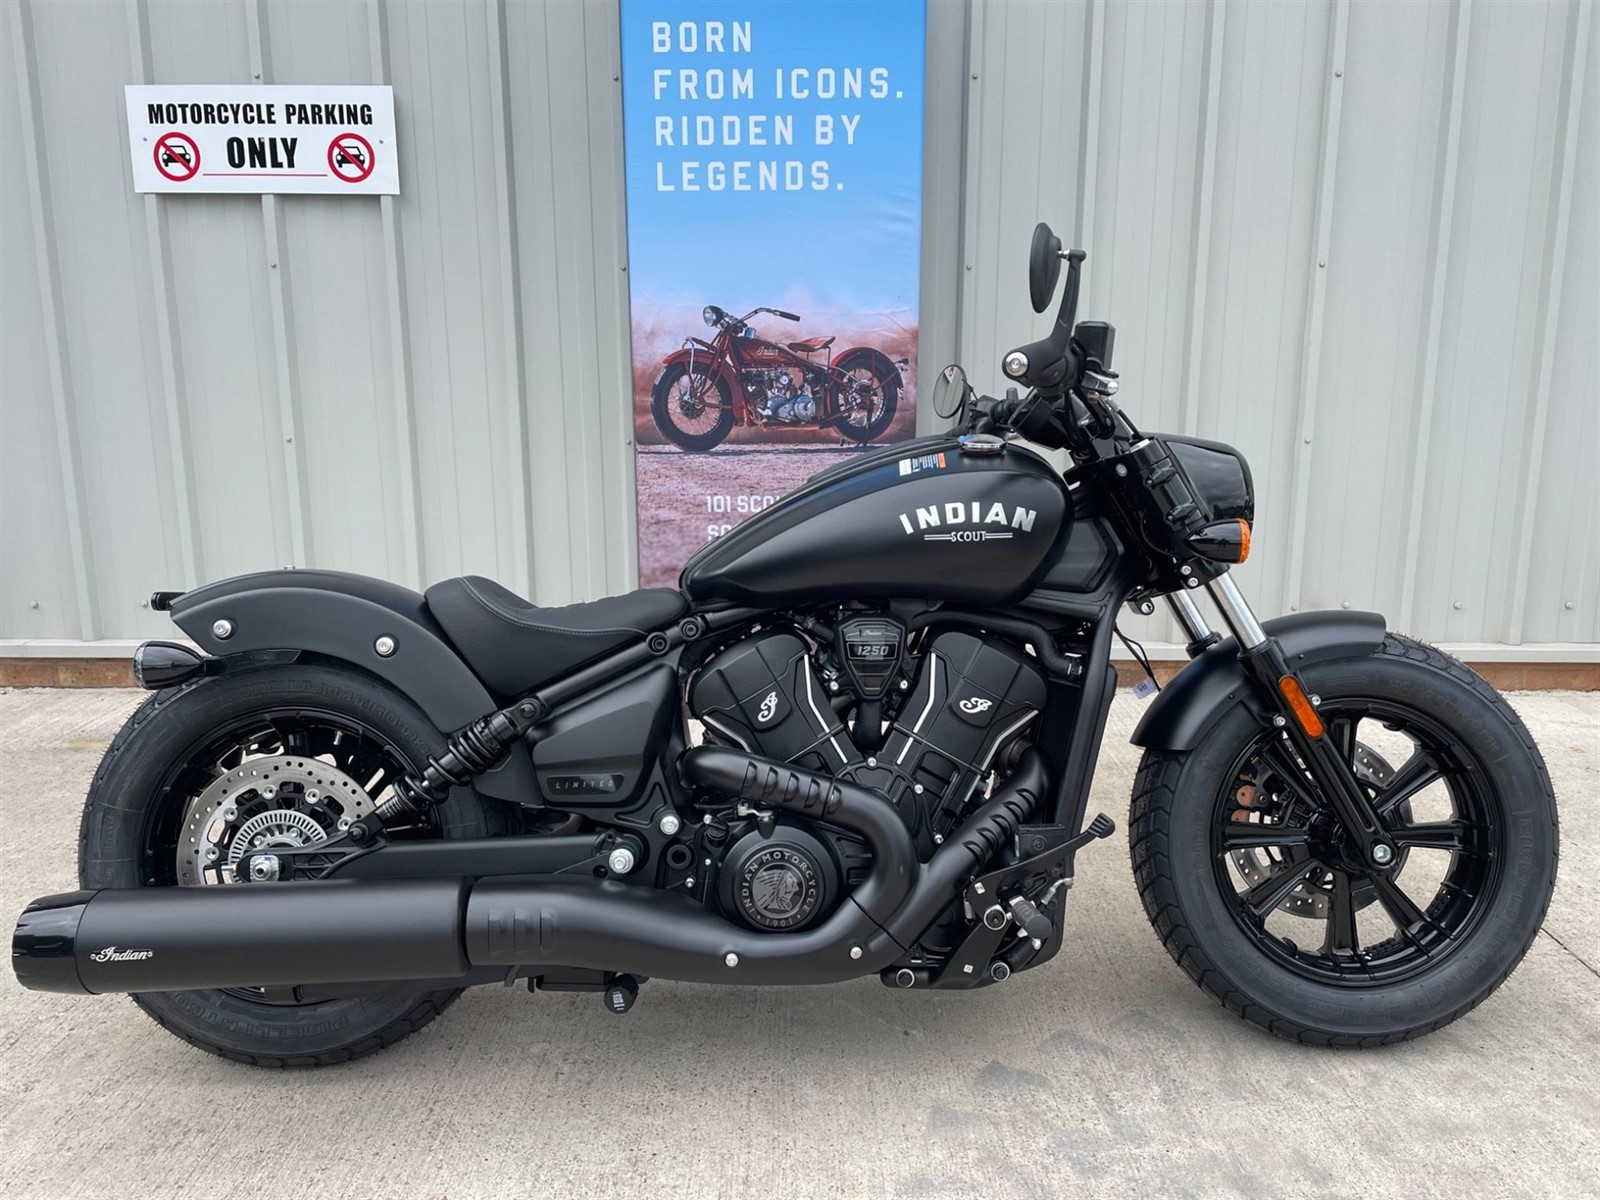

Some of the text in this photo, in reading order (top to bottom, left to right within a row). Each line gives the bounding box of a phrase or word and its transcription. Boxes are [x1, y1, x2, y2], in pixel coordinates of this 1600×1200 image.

[652, 21, 751, 53] BORN
[653, 67, 903, 100] FROM ICONS.
[147, 103, 373, 125] MOTORCYCLE PARKING
[655, 114, 861, 146] RIDDEN BY
[226, 137, 298, 169] ONLY
[656, 161, 843, 192] LEGENDS.
[706, 495, 780, 512] 101 SCO
[899, 502, 1037, 535] INDIAN
[950, 531, 986, 542] SCOUT
[857, 645, 889, 656] 1250
[556, 780, 614, 789] LIMITED
[742, 851, 817, 913] INDIAN MOTORCYCLE
[765, 918, 793, 928] 1901
[95, 946, 148, 962] Indian
